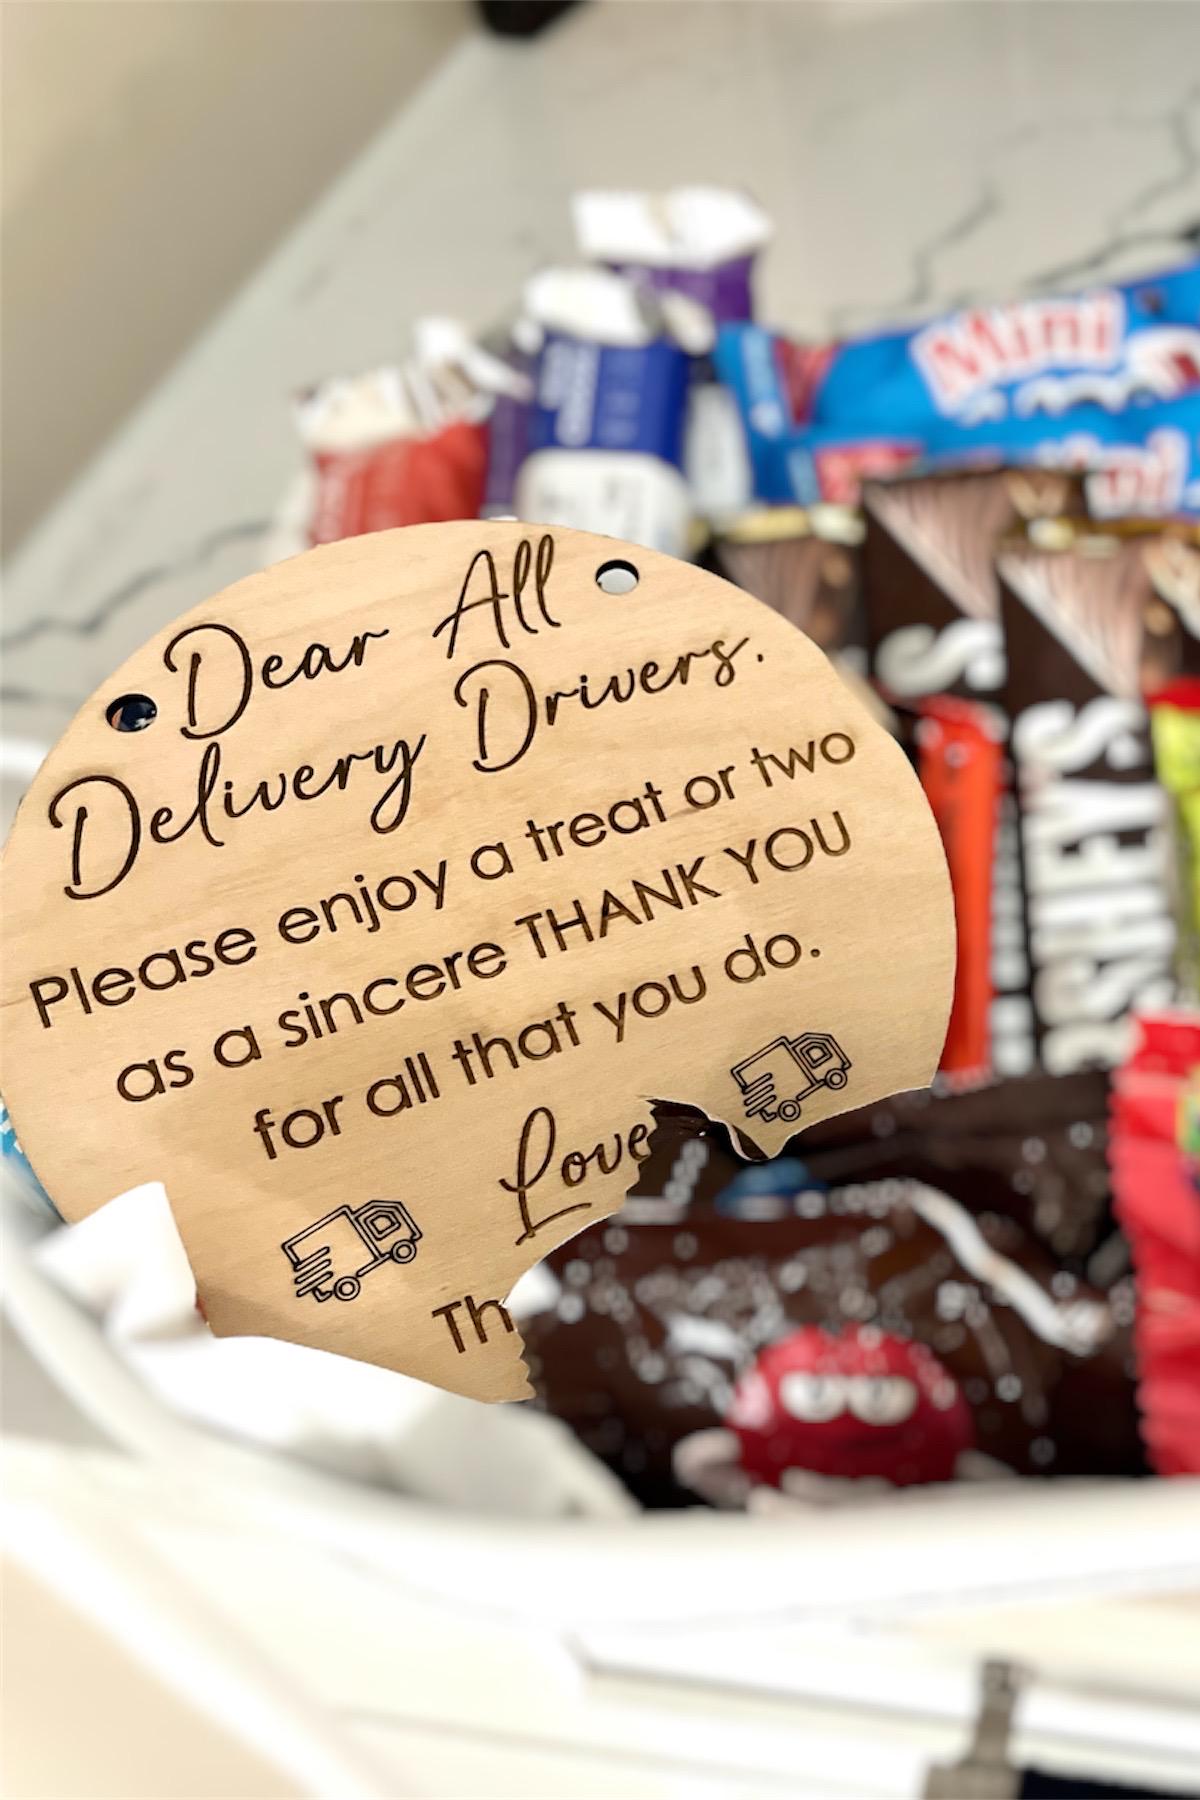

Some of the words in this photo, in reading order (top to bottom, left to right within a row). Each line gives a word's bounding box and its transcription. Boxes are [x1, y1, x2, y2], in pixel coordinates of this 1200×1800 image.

[163, 623, 390, 740] Dear
[431, 534, 562, 660] All
[28, 927, 258, 1029] Please
[278, 859, 447, 945] enjoy
[470, 841, 514, 881] a
[524, 781, 667, 862] treat
[684, 765, 736, 810] or
[750, 732, 855, 788] two
[47, 733, 427, 901] Delivery
[116, 1049, 194, 1103] as
[213, 1025, 262, 1069] a
[278, 942, 508, 1048] sincere
[514, 856, 722, 959] THANK
[722, 810, 851, 885] YOU
[253, 1095, 344, 1160] for
[366, 1051, 441, 1118] all
[451, 1001, 581, 1086] that
[592, 965, 707, 1043] you
[724, 930, 821, 984] do.
[431, 1294, 515, 1354] Th
